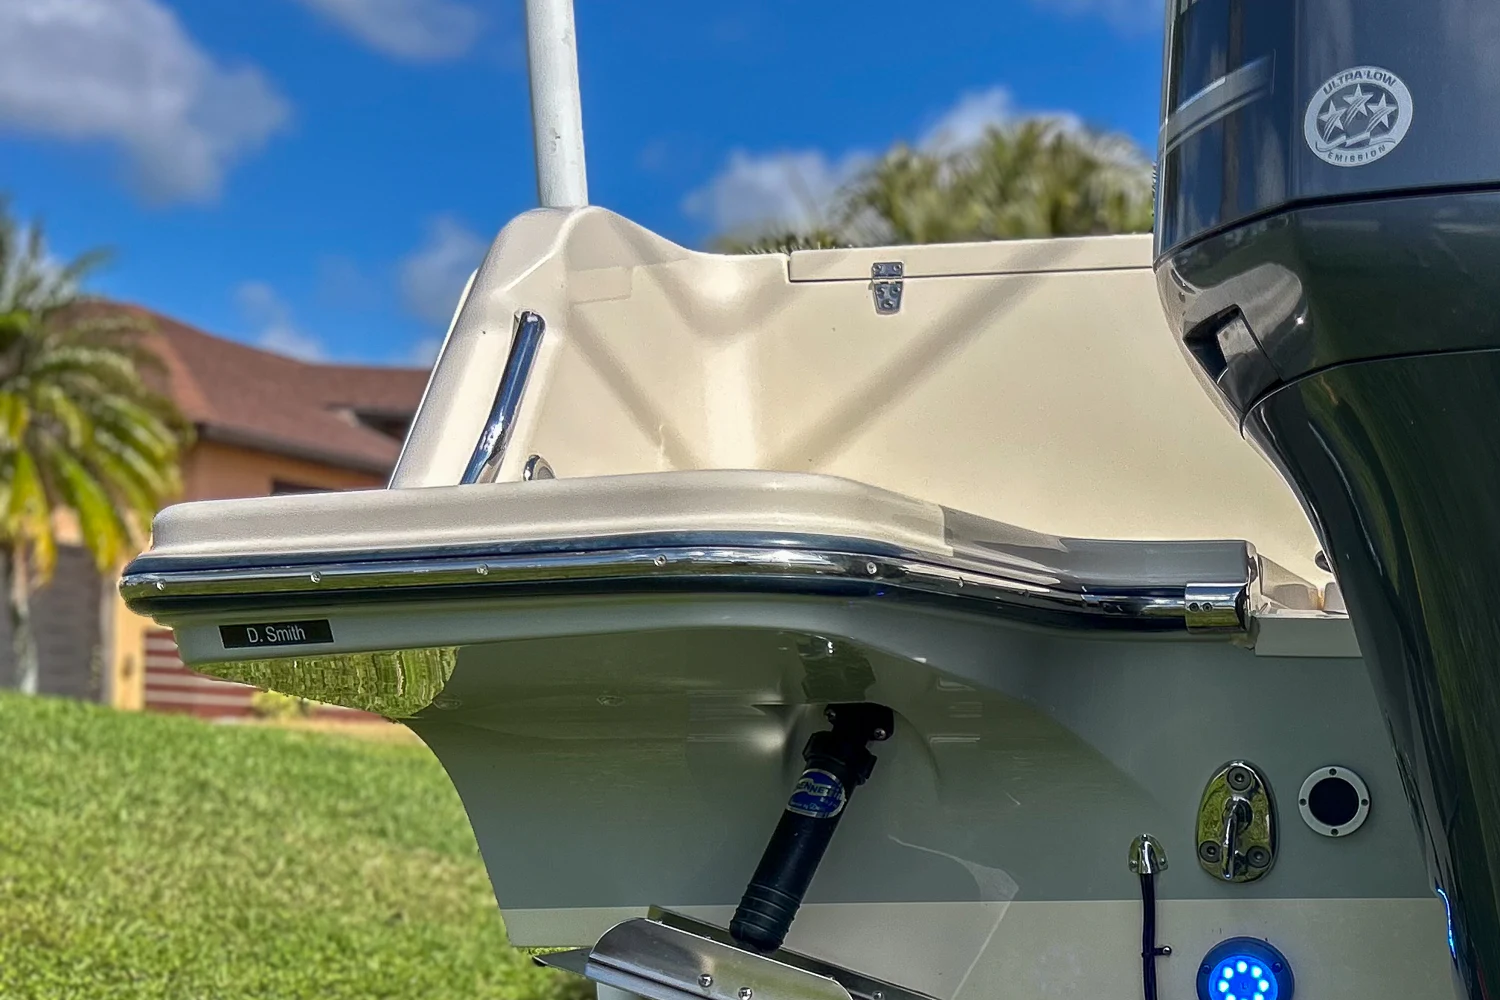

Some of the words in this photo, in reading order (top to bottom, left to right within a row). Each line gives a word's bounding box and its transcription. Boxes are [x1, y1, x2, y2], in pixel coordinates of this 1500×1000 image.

[1322, 70, 1363, 95] ULTRA
[1366, 70, 1397, 87] LOW
[1327, 144, 1386, 162] EMISSION
[246, 627, 263, 643] D.
[266, 625, 306, 642] Smith
